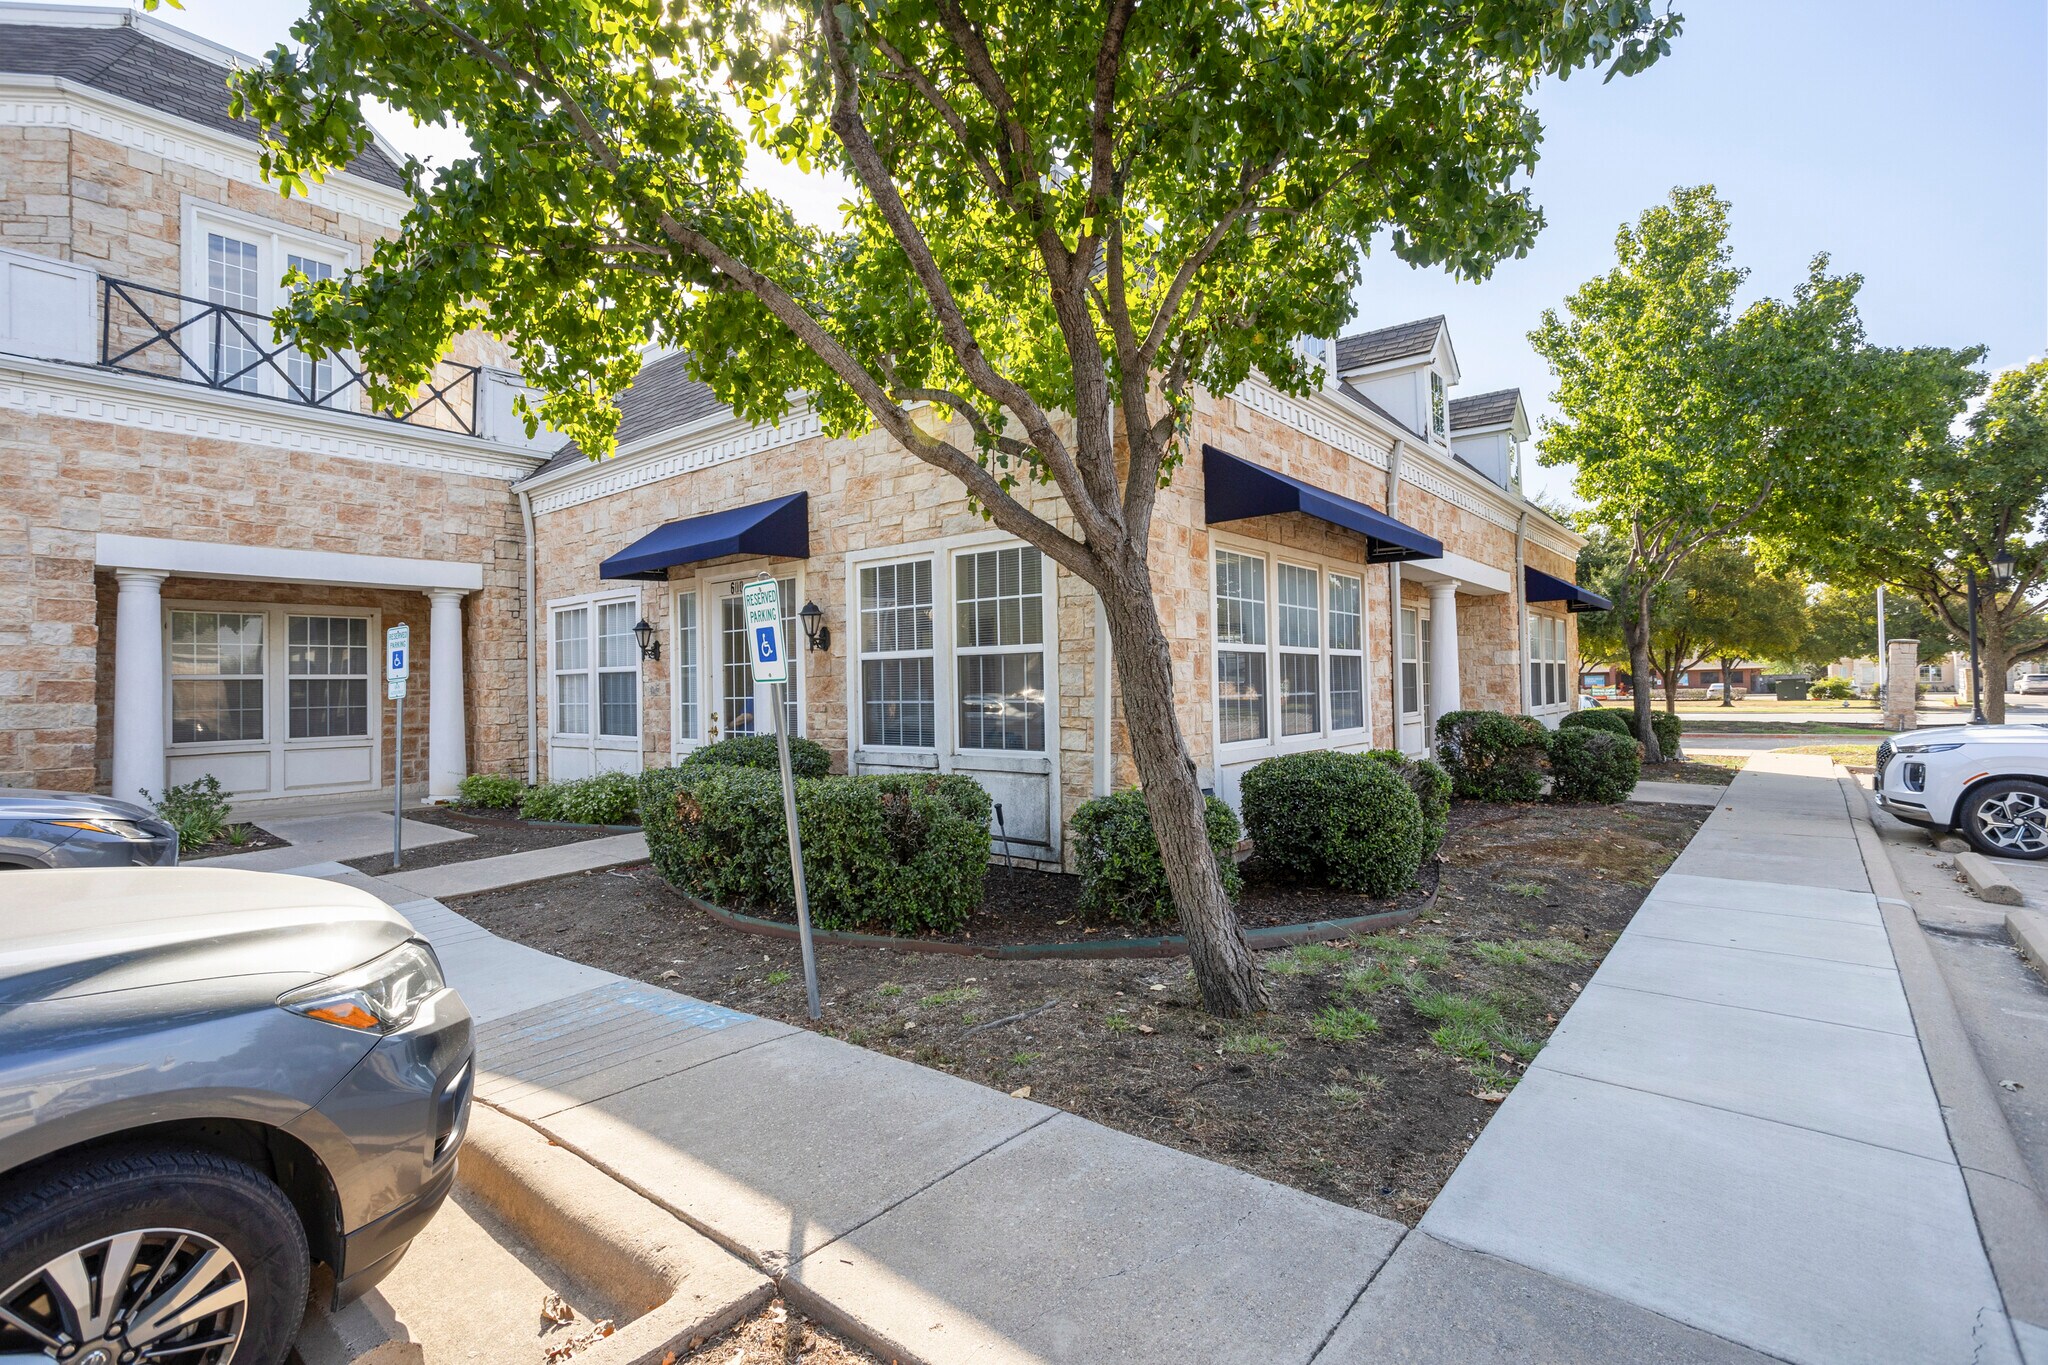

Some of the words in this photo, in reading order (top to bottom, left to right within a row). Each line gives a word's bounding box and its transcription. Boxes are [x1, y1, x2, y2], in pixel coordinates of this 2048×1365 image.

[746, 590, 776, 606] RESERVED
[750, 608, 776, 623] PARKING
[389, 632, 407, 640] RESERVED
[390, 640, 406, 648] PARKING
